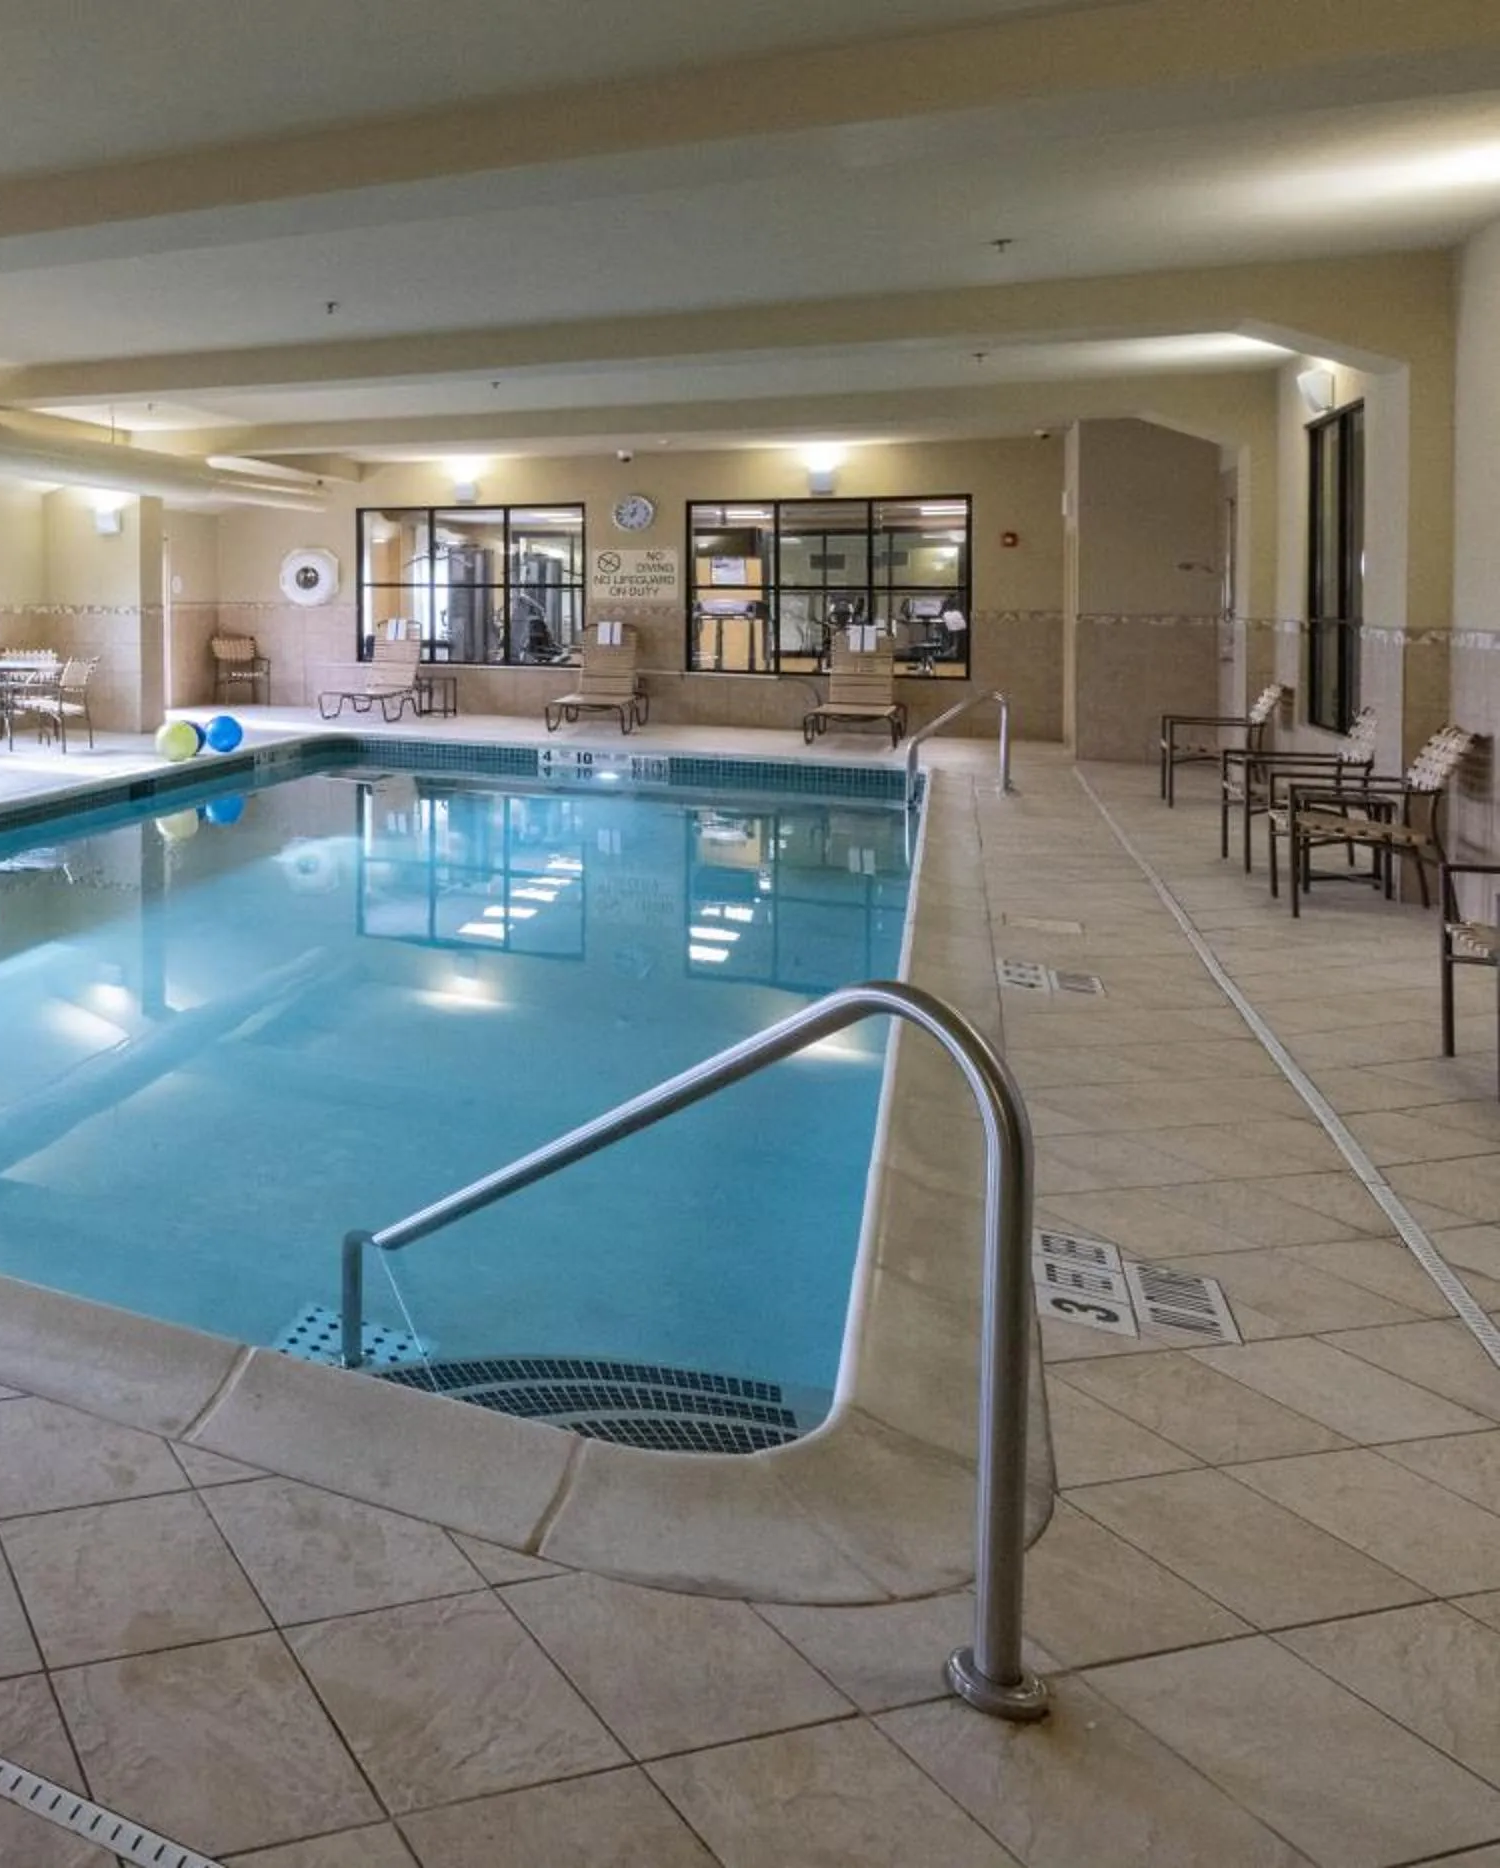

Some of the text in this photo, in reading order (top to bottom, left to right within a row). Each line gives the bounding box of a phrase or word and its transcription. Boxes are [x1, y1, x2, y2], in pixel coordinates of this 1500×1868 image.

[646, 551, 665, 560] NO
[594, 575, 674, 584] NO LIFEGUARD
[610, 586, 659, 596] ON DUTY
[542, 750, 552, 762] 4
[576, 752, 593, 764] 10
[1051, 1297, 1119, 1324] 3
